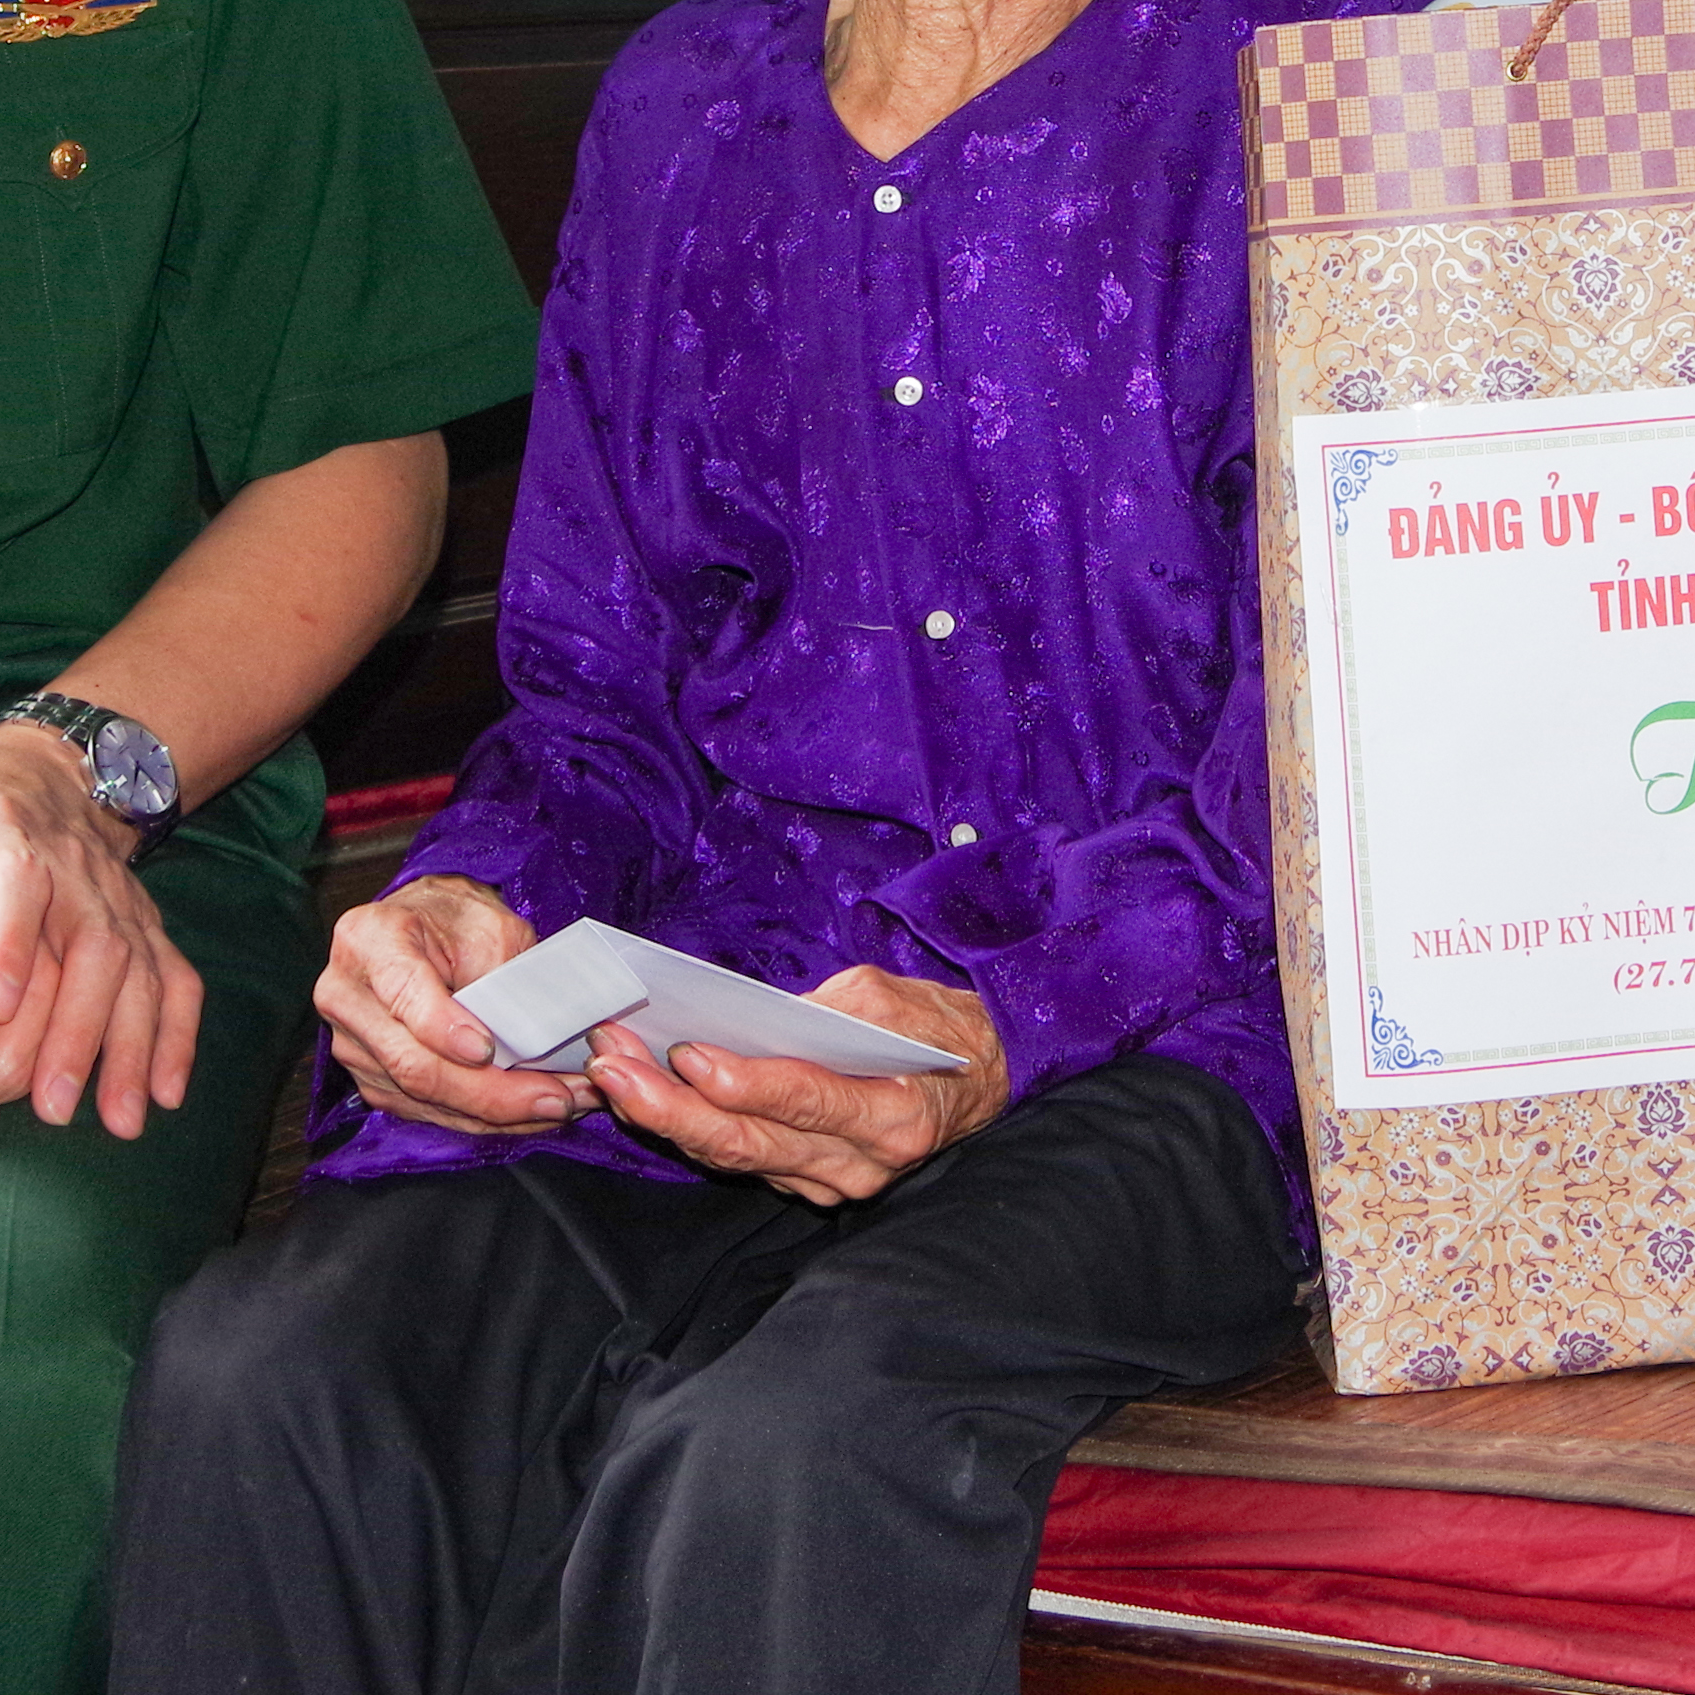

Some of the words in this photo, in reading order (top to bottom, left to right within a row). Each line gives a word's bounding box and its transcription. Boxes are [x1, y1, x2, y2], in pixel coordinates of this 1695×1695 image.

[1388, 481, 1525, 559] ĐẢNG
[1541, 472, 1600, 546] ỦY
[1412, 917, 1492, 958] NHÂN
[1502, 920, 1550, 956] DỊP
[1558, 902, 1593, 945] KỶ
[1603, 899, 1675, 944] NIỆM
